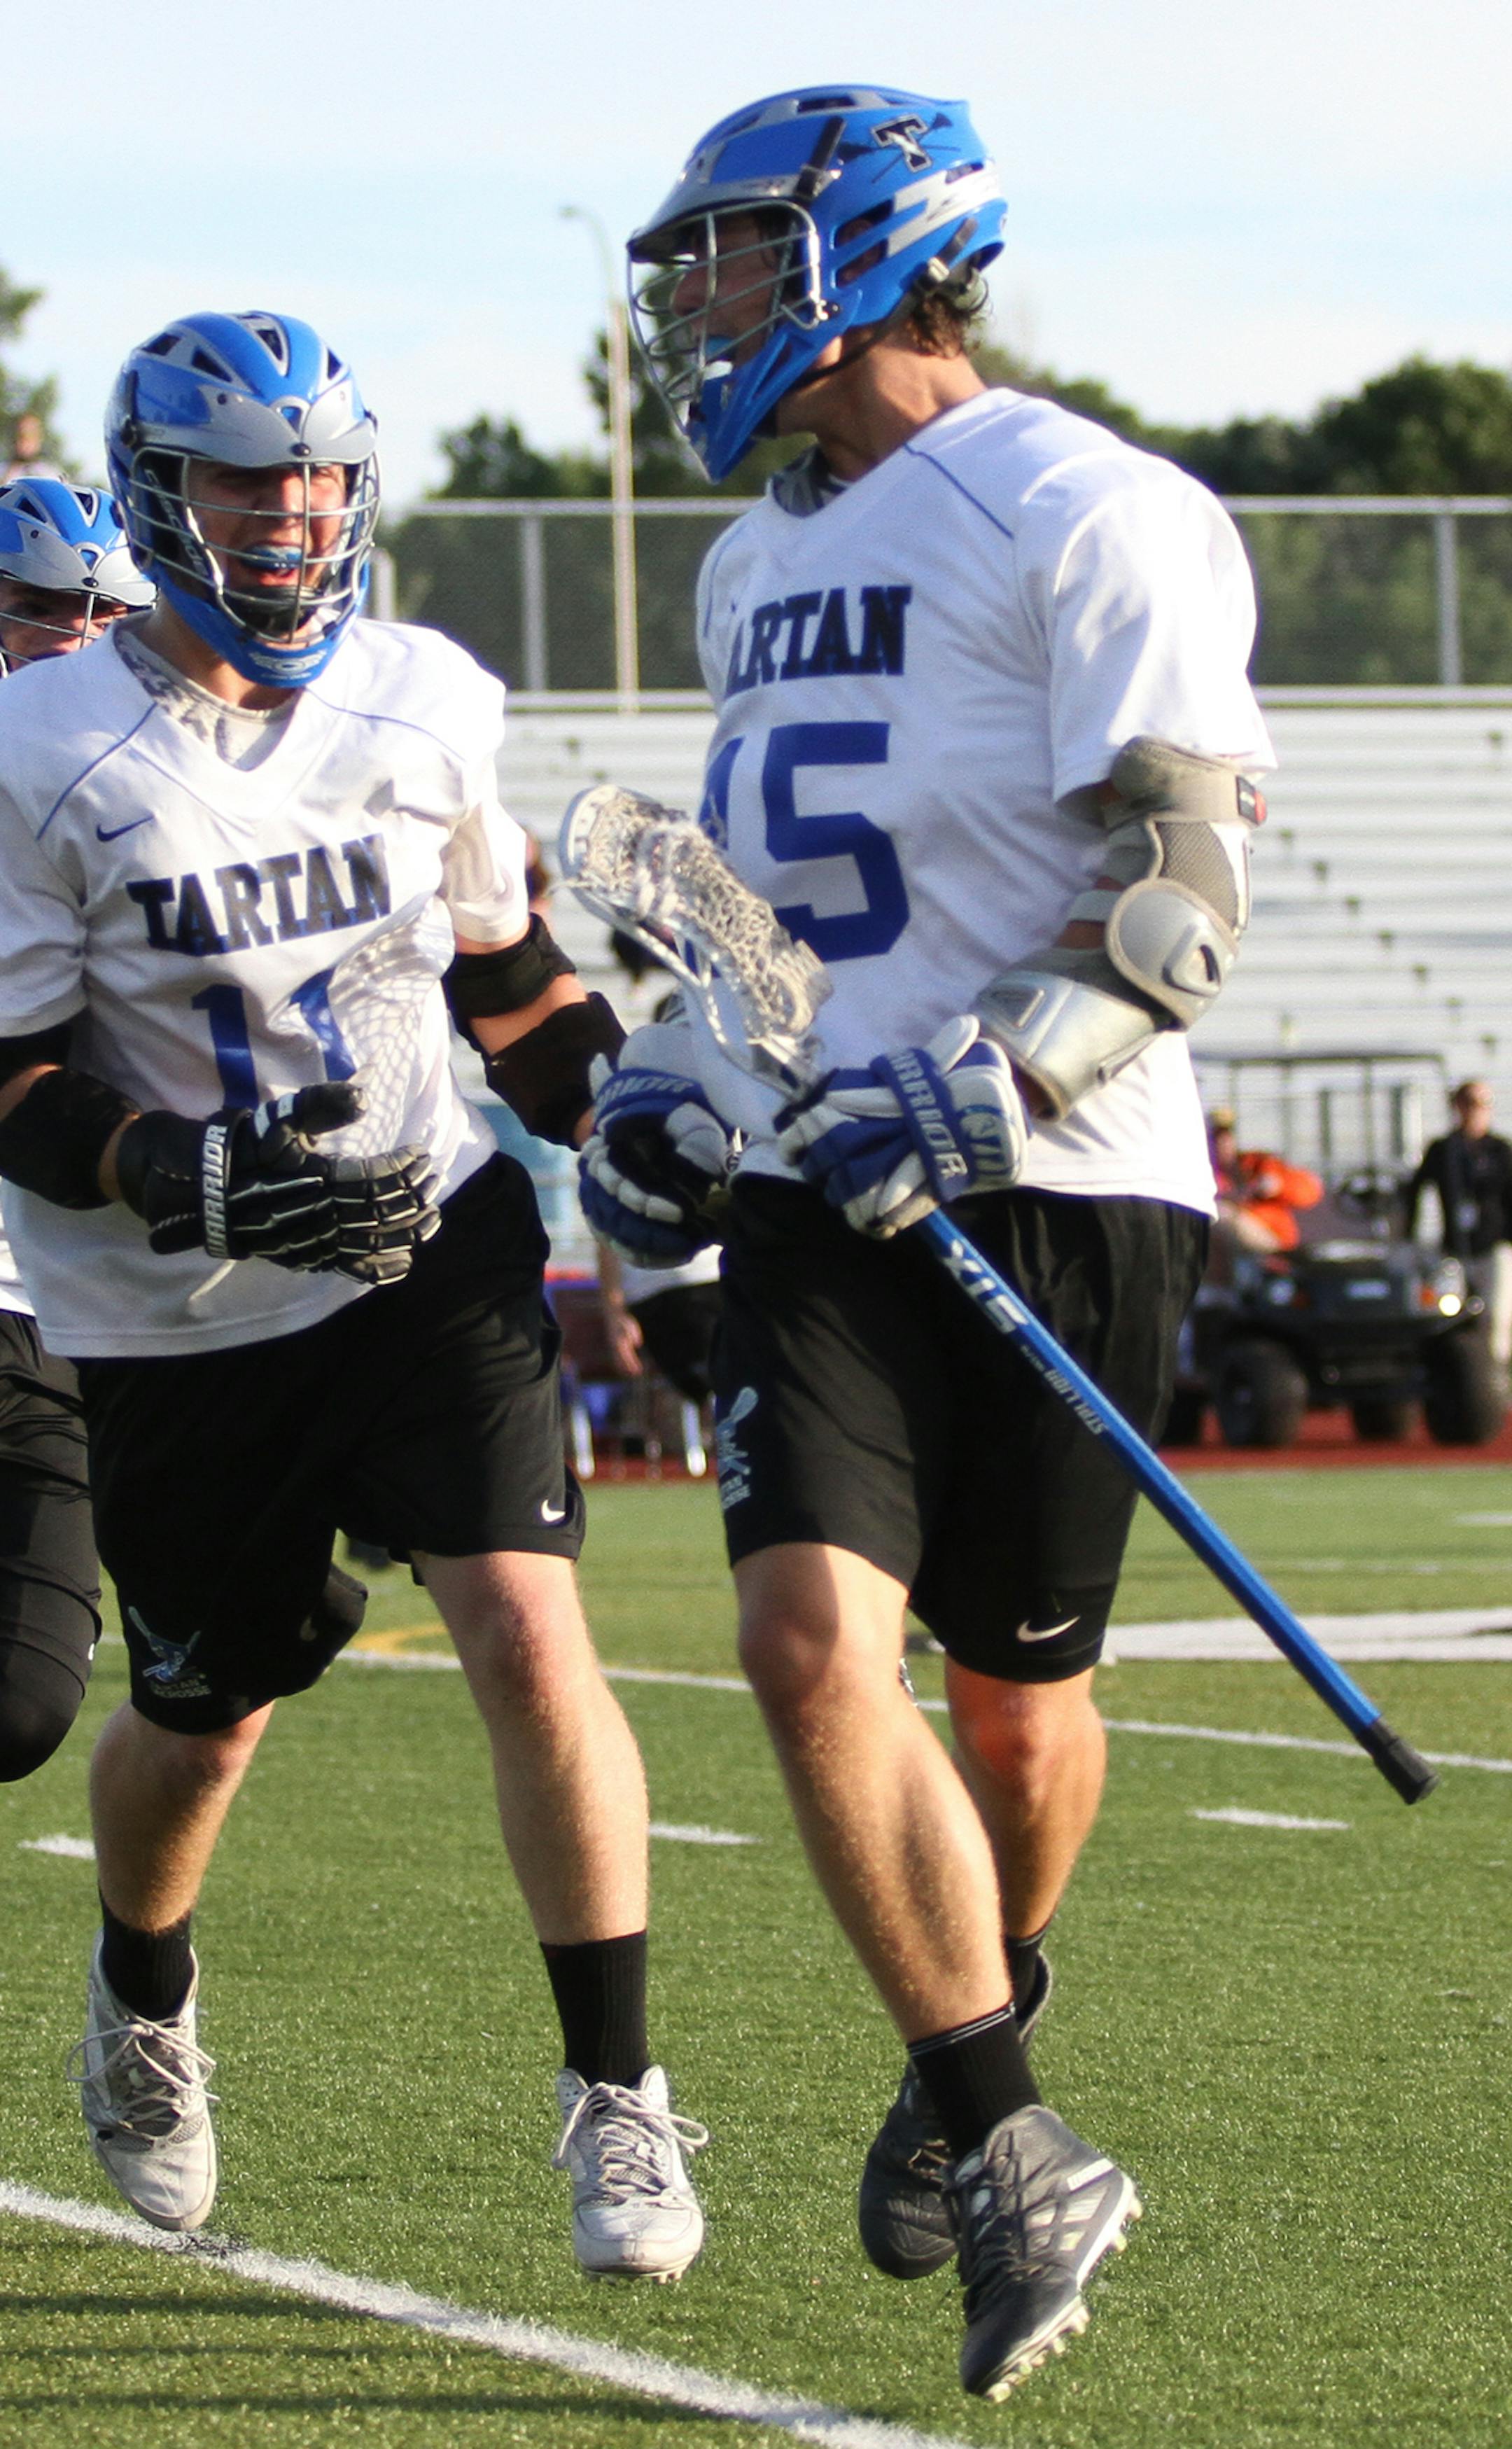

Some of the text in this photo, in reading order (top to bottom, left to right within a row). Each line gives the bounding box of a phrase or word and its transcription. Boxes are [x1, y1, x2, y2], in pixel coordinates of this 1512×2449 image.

[872, 113, 932, 173] T
[126, 832, 391, 957] TARTAN
[203, 1124, 228, 1258] WARRIOR
[943, 1239, 1029, 1334] STX
